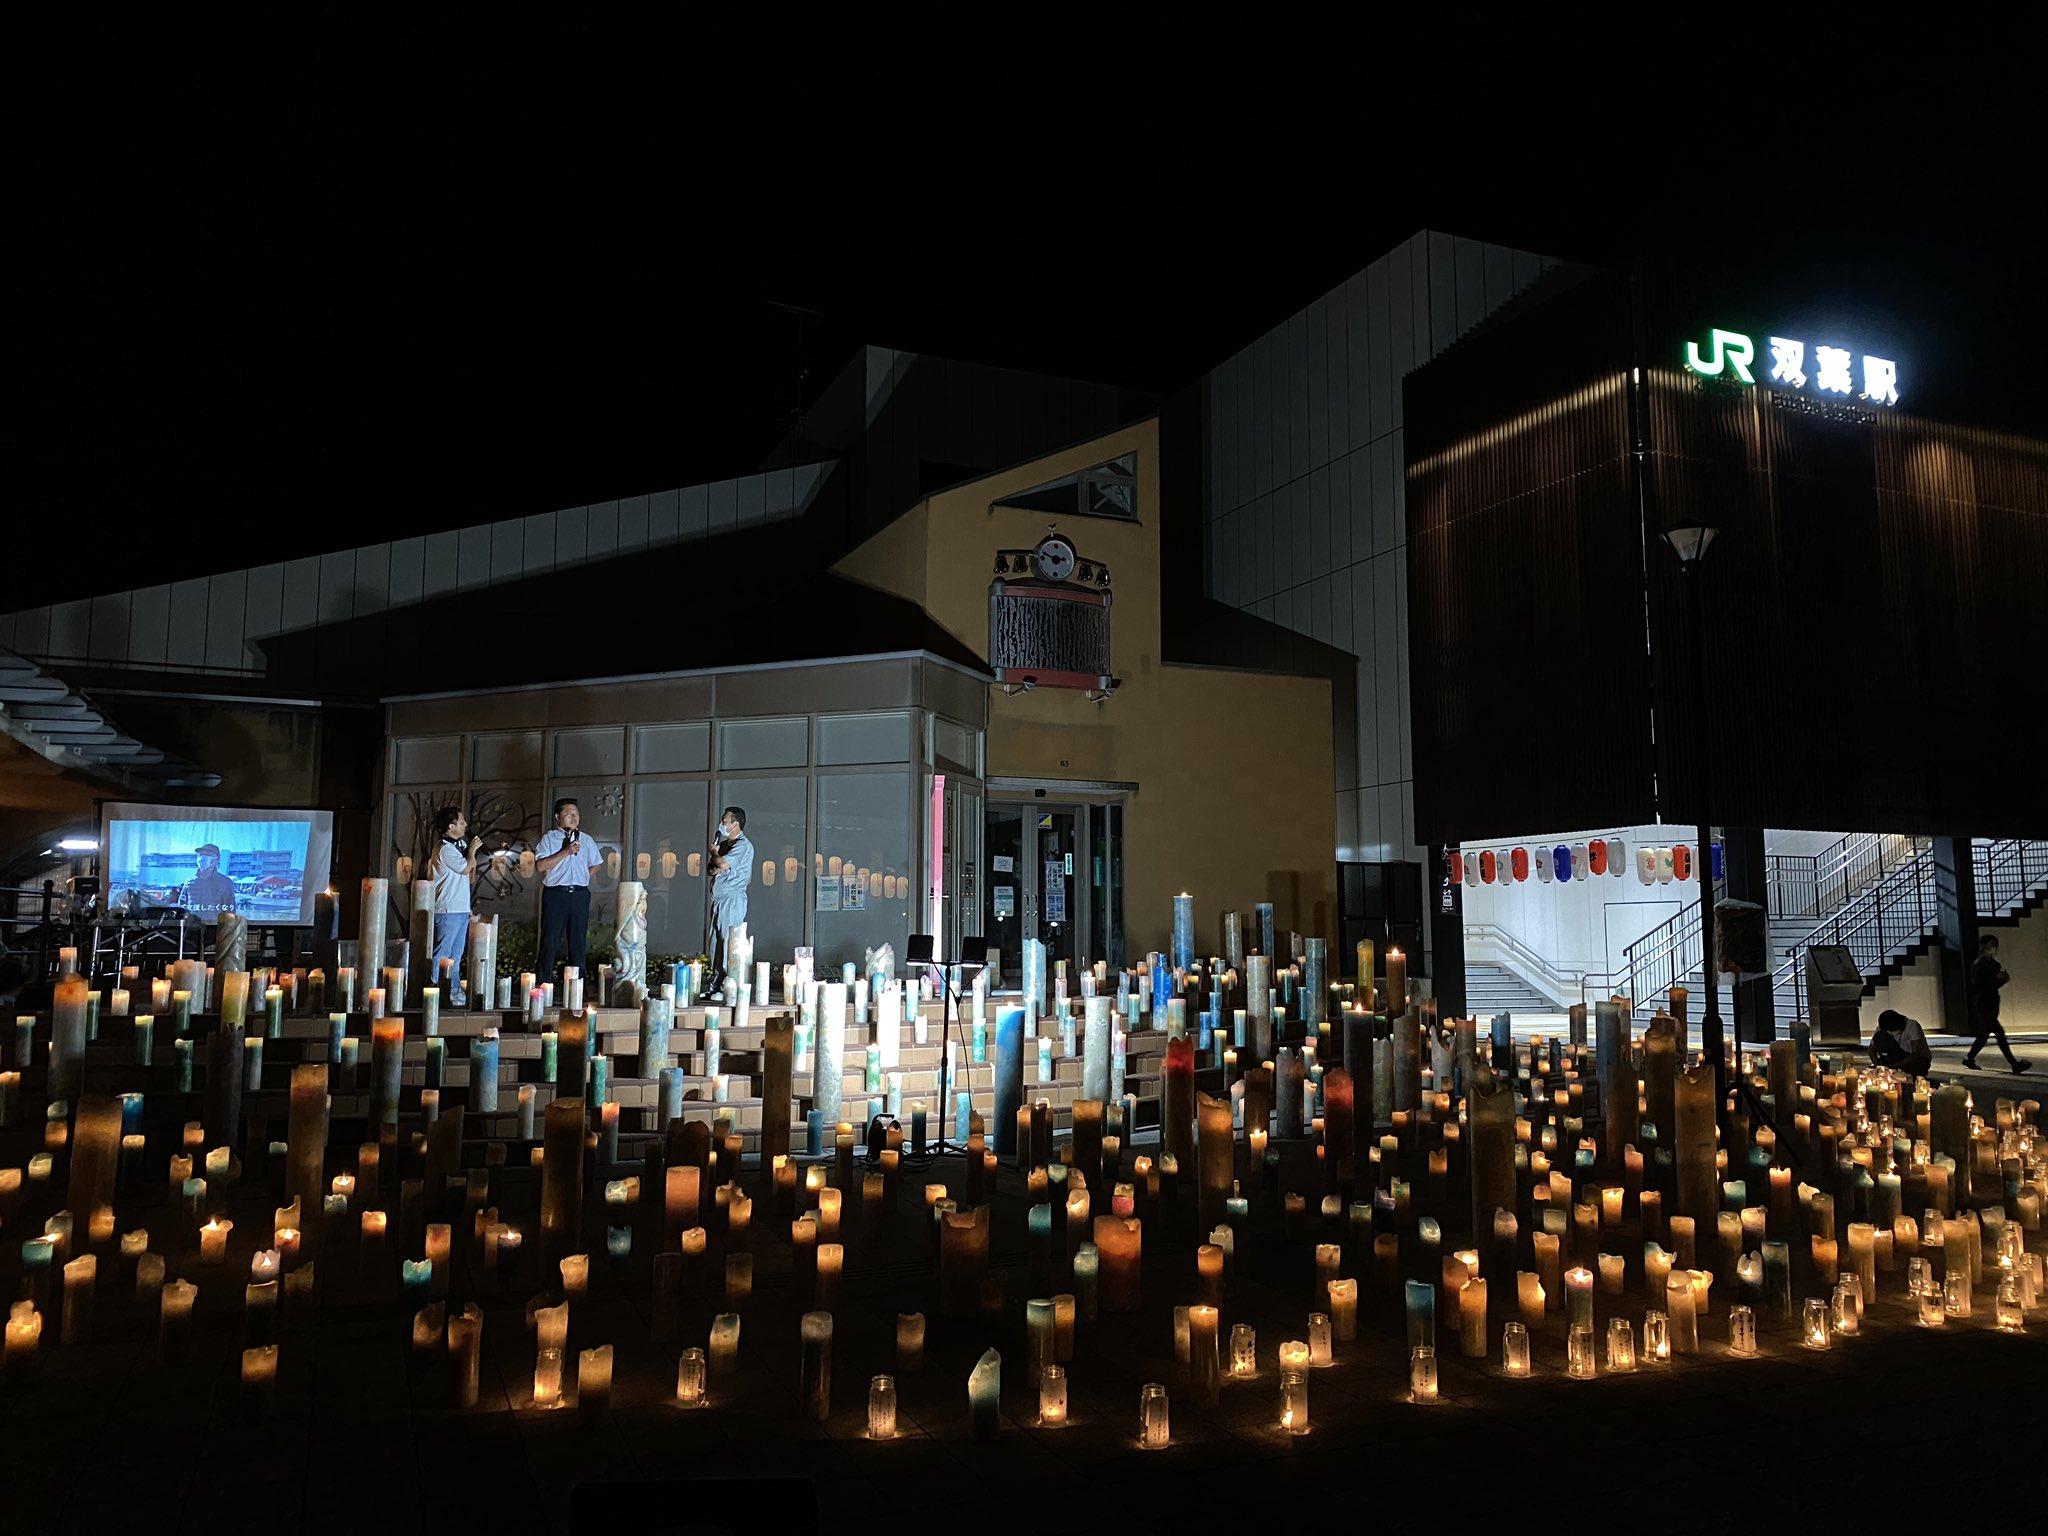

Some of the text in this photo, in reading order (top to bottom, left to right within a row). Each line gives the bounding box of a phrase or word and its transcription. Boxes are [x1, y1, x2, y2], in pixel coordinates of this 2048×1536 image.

[1686, 328, 1899, 406] JR 双葉駅
